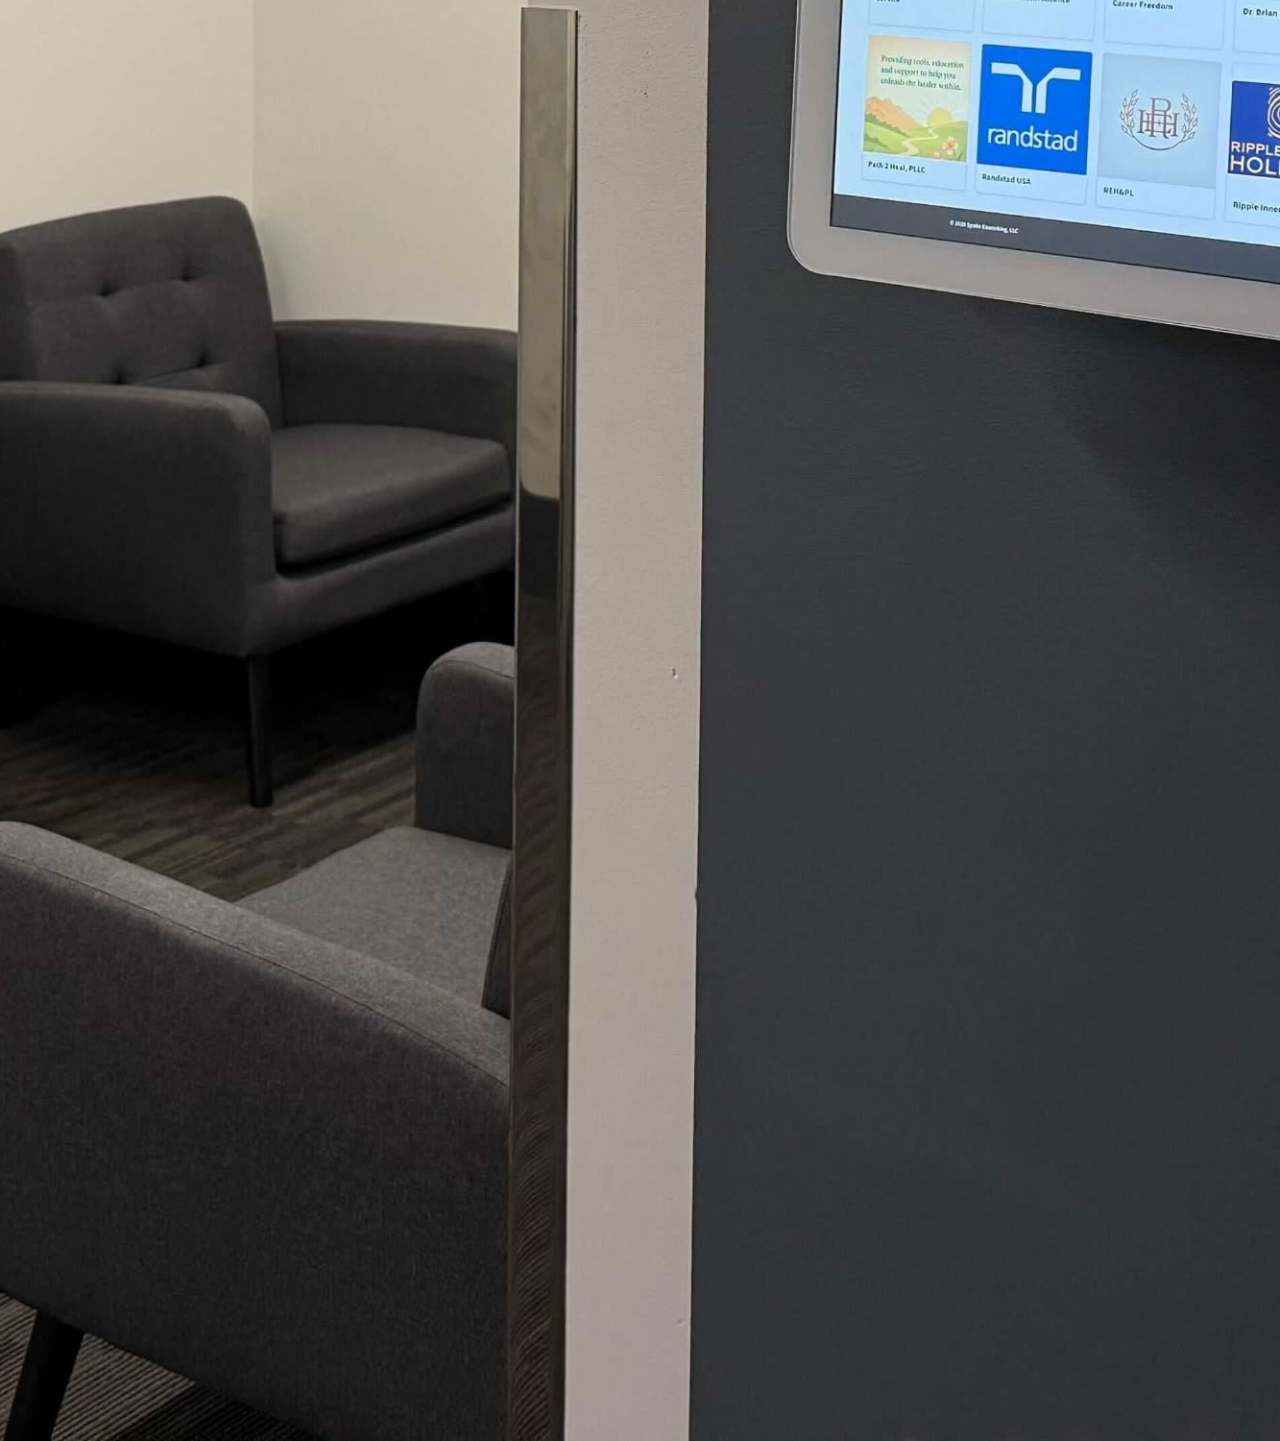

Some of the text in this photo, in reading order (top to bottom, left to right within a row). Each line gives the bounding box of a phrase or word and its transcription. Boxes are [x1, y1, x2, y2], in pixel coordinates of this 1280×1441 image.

[1112, 0, 1174, 10] Career Freedom
[1256, 9, 1278, 17] Brian
[881, 55, 912, 66] Providing
[881, 65, 893, 74] and
[987, 125, 1079, 152] randstad
[909, 165, 926, 174] PLLC
[982, 173, 1032, 185] Randstad USA
[1233, 201, 1258, 212] Ripple
